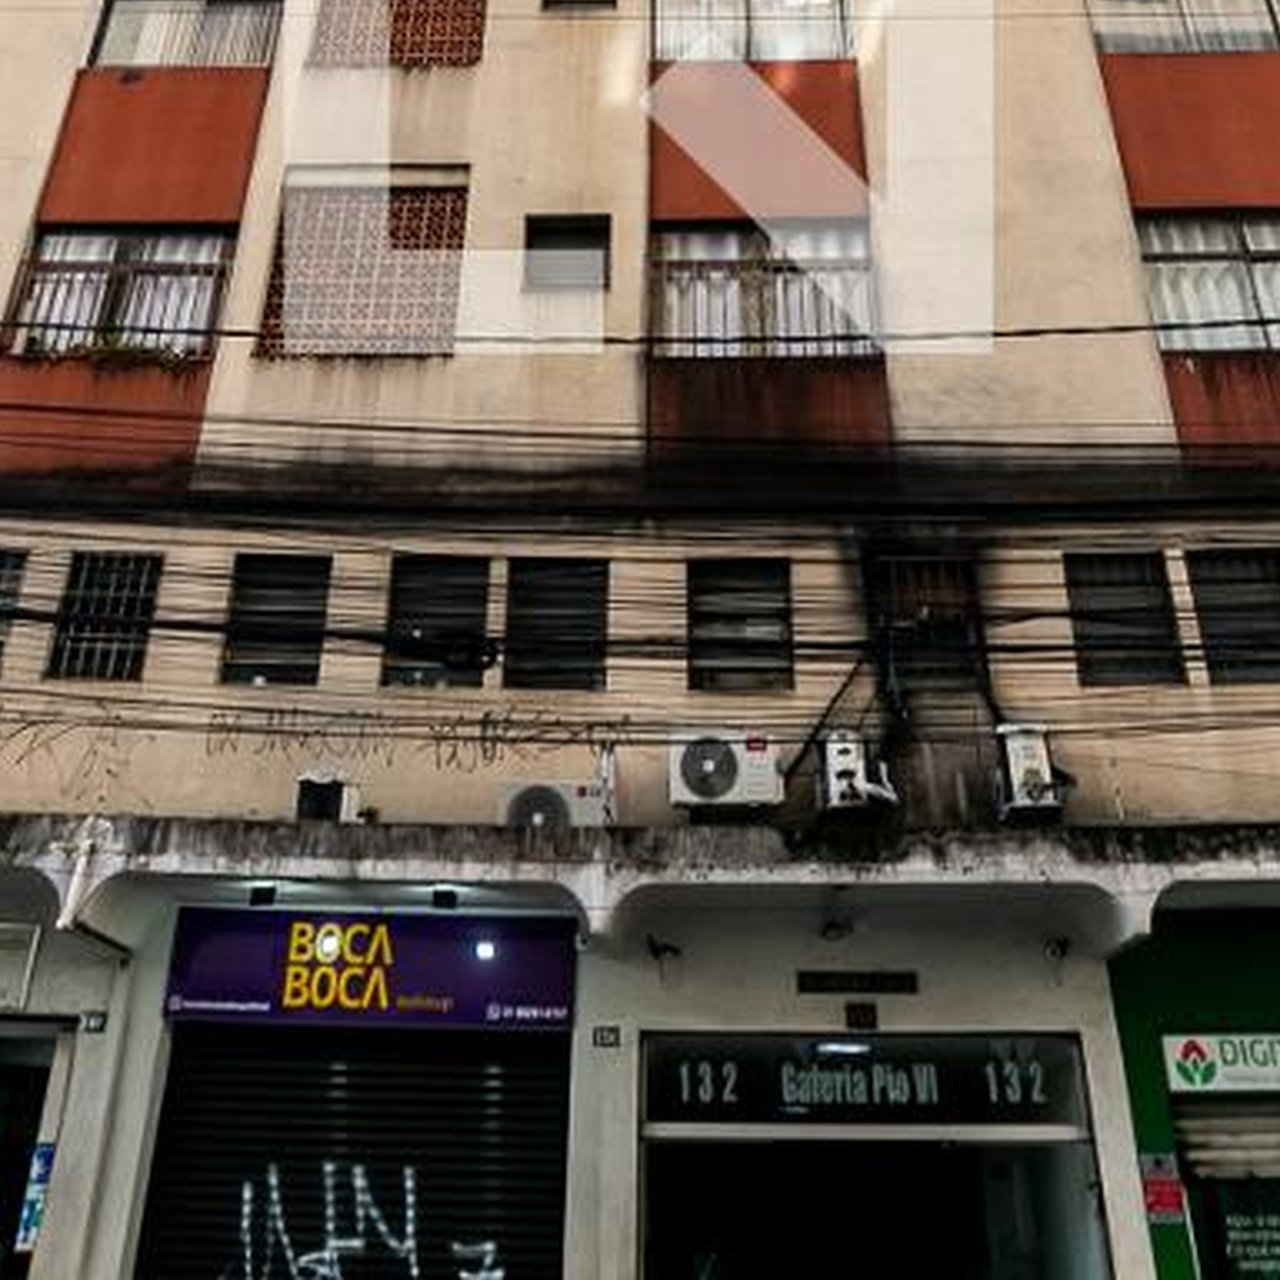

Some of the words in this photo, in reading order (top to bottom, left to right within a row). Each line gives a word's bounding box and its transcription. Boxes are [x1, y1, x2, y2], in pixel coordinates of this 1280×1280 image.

[288, 922, 393, 966] BOCA
[282, 965, 389, 1010] BOCA
[679, 1061, 738, 1104] 132
[781, 1060, 869, 1104] Galeria
[985, 1061, 1048, 1104] 132
